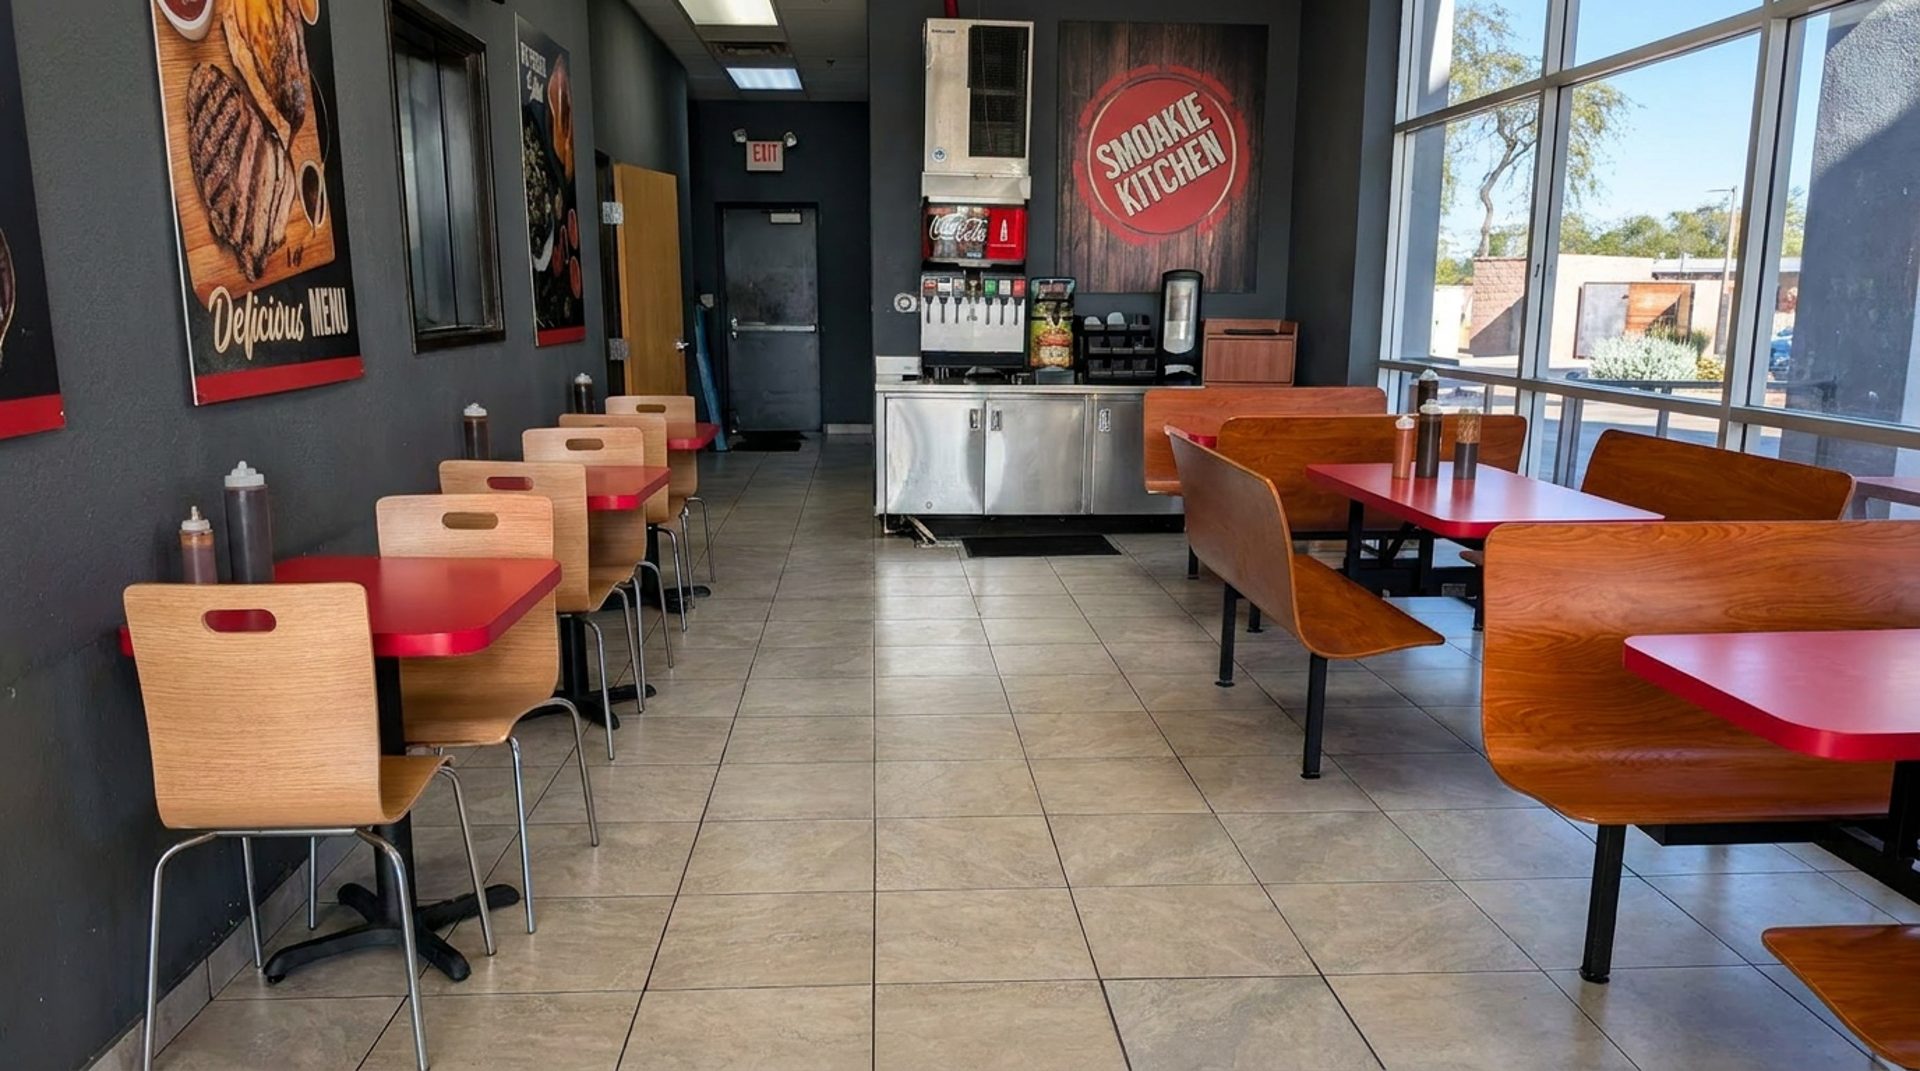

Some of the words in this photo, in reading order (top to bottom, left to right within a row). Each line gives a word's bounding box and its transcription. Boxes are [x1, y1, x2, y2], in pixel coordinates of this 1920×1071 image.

[1096, 91, 1211, 179] SMOAKIE
[1114, 128, 1226, 217] KITCHEN
[208, 285, 304, 361] Delicious
[307, 287, 349, 337] MENU
